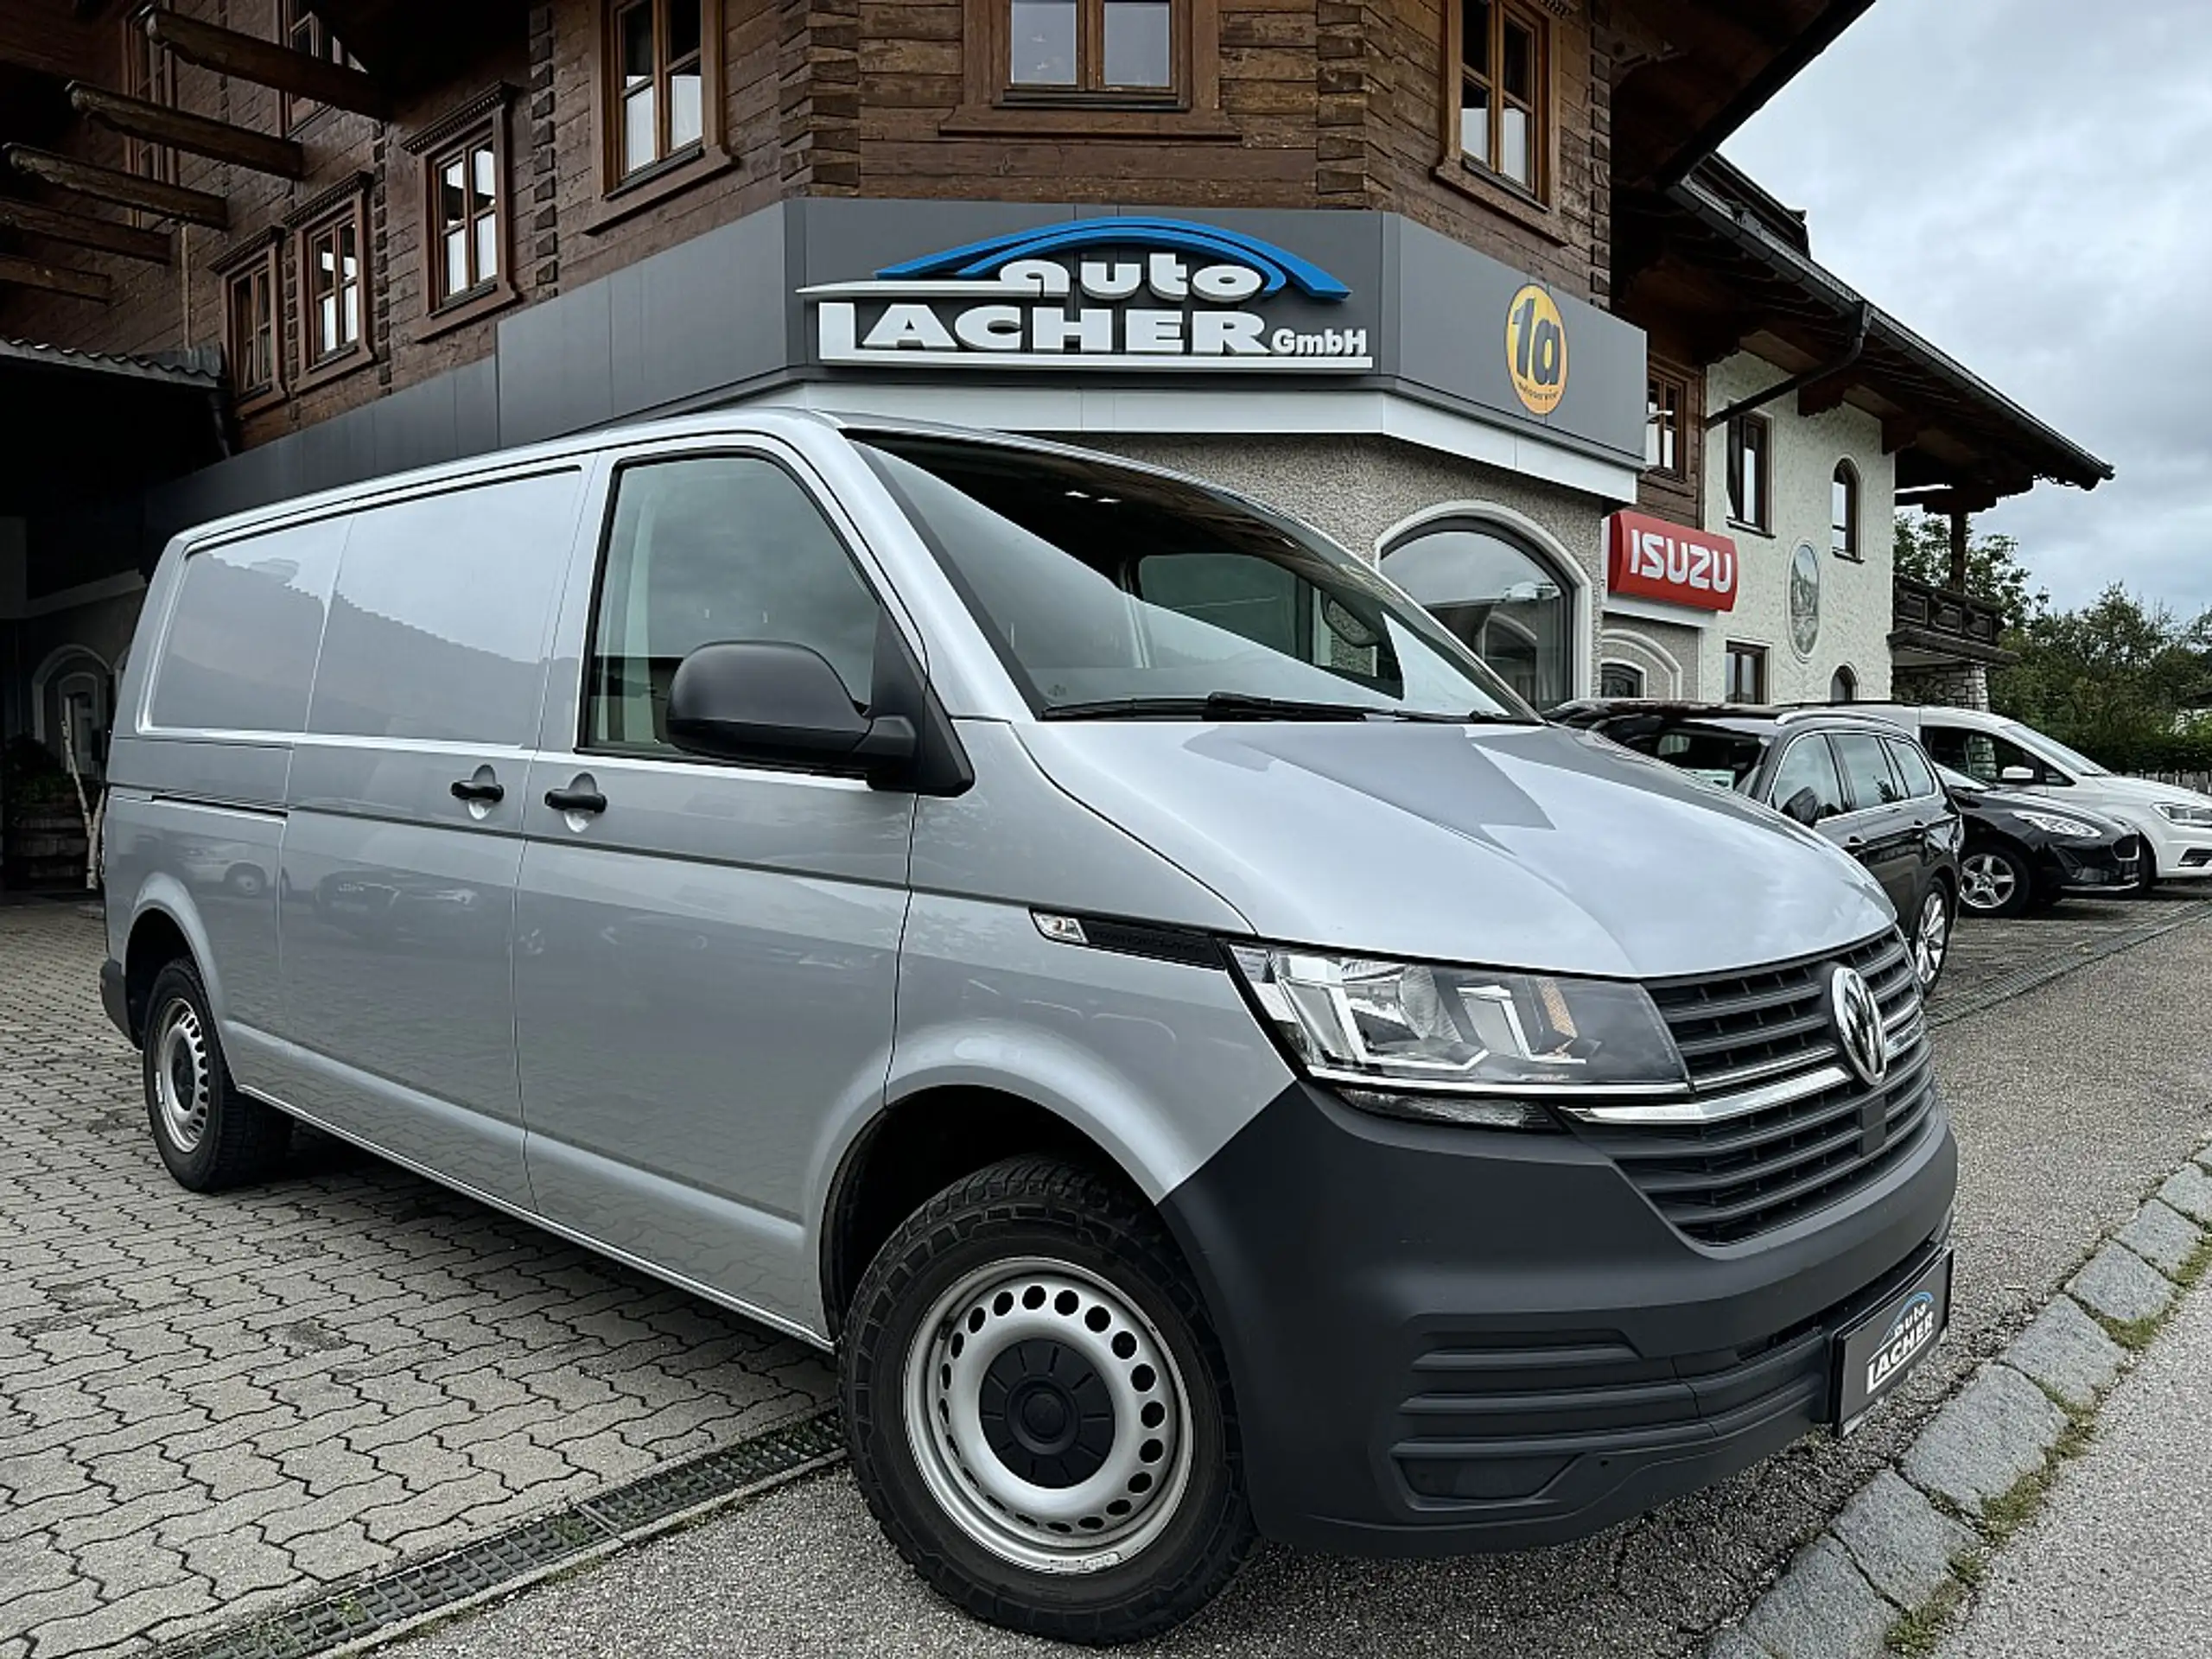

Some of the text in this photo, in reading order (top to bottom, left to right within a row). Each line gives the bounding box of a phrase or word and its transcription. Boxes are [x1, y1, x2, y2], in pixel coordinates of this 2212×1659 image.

[998, 252, 1263, 302] auto
[818, 302, 1369, 359] LACHER GmbH
[1630, 528, 1732, 594] ISUZU
[1866, 1310, 1935, 1395] LACHER
